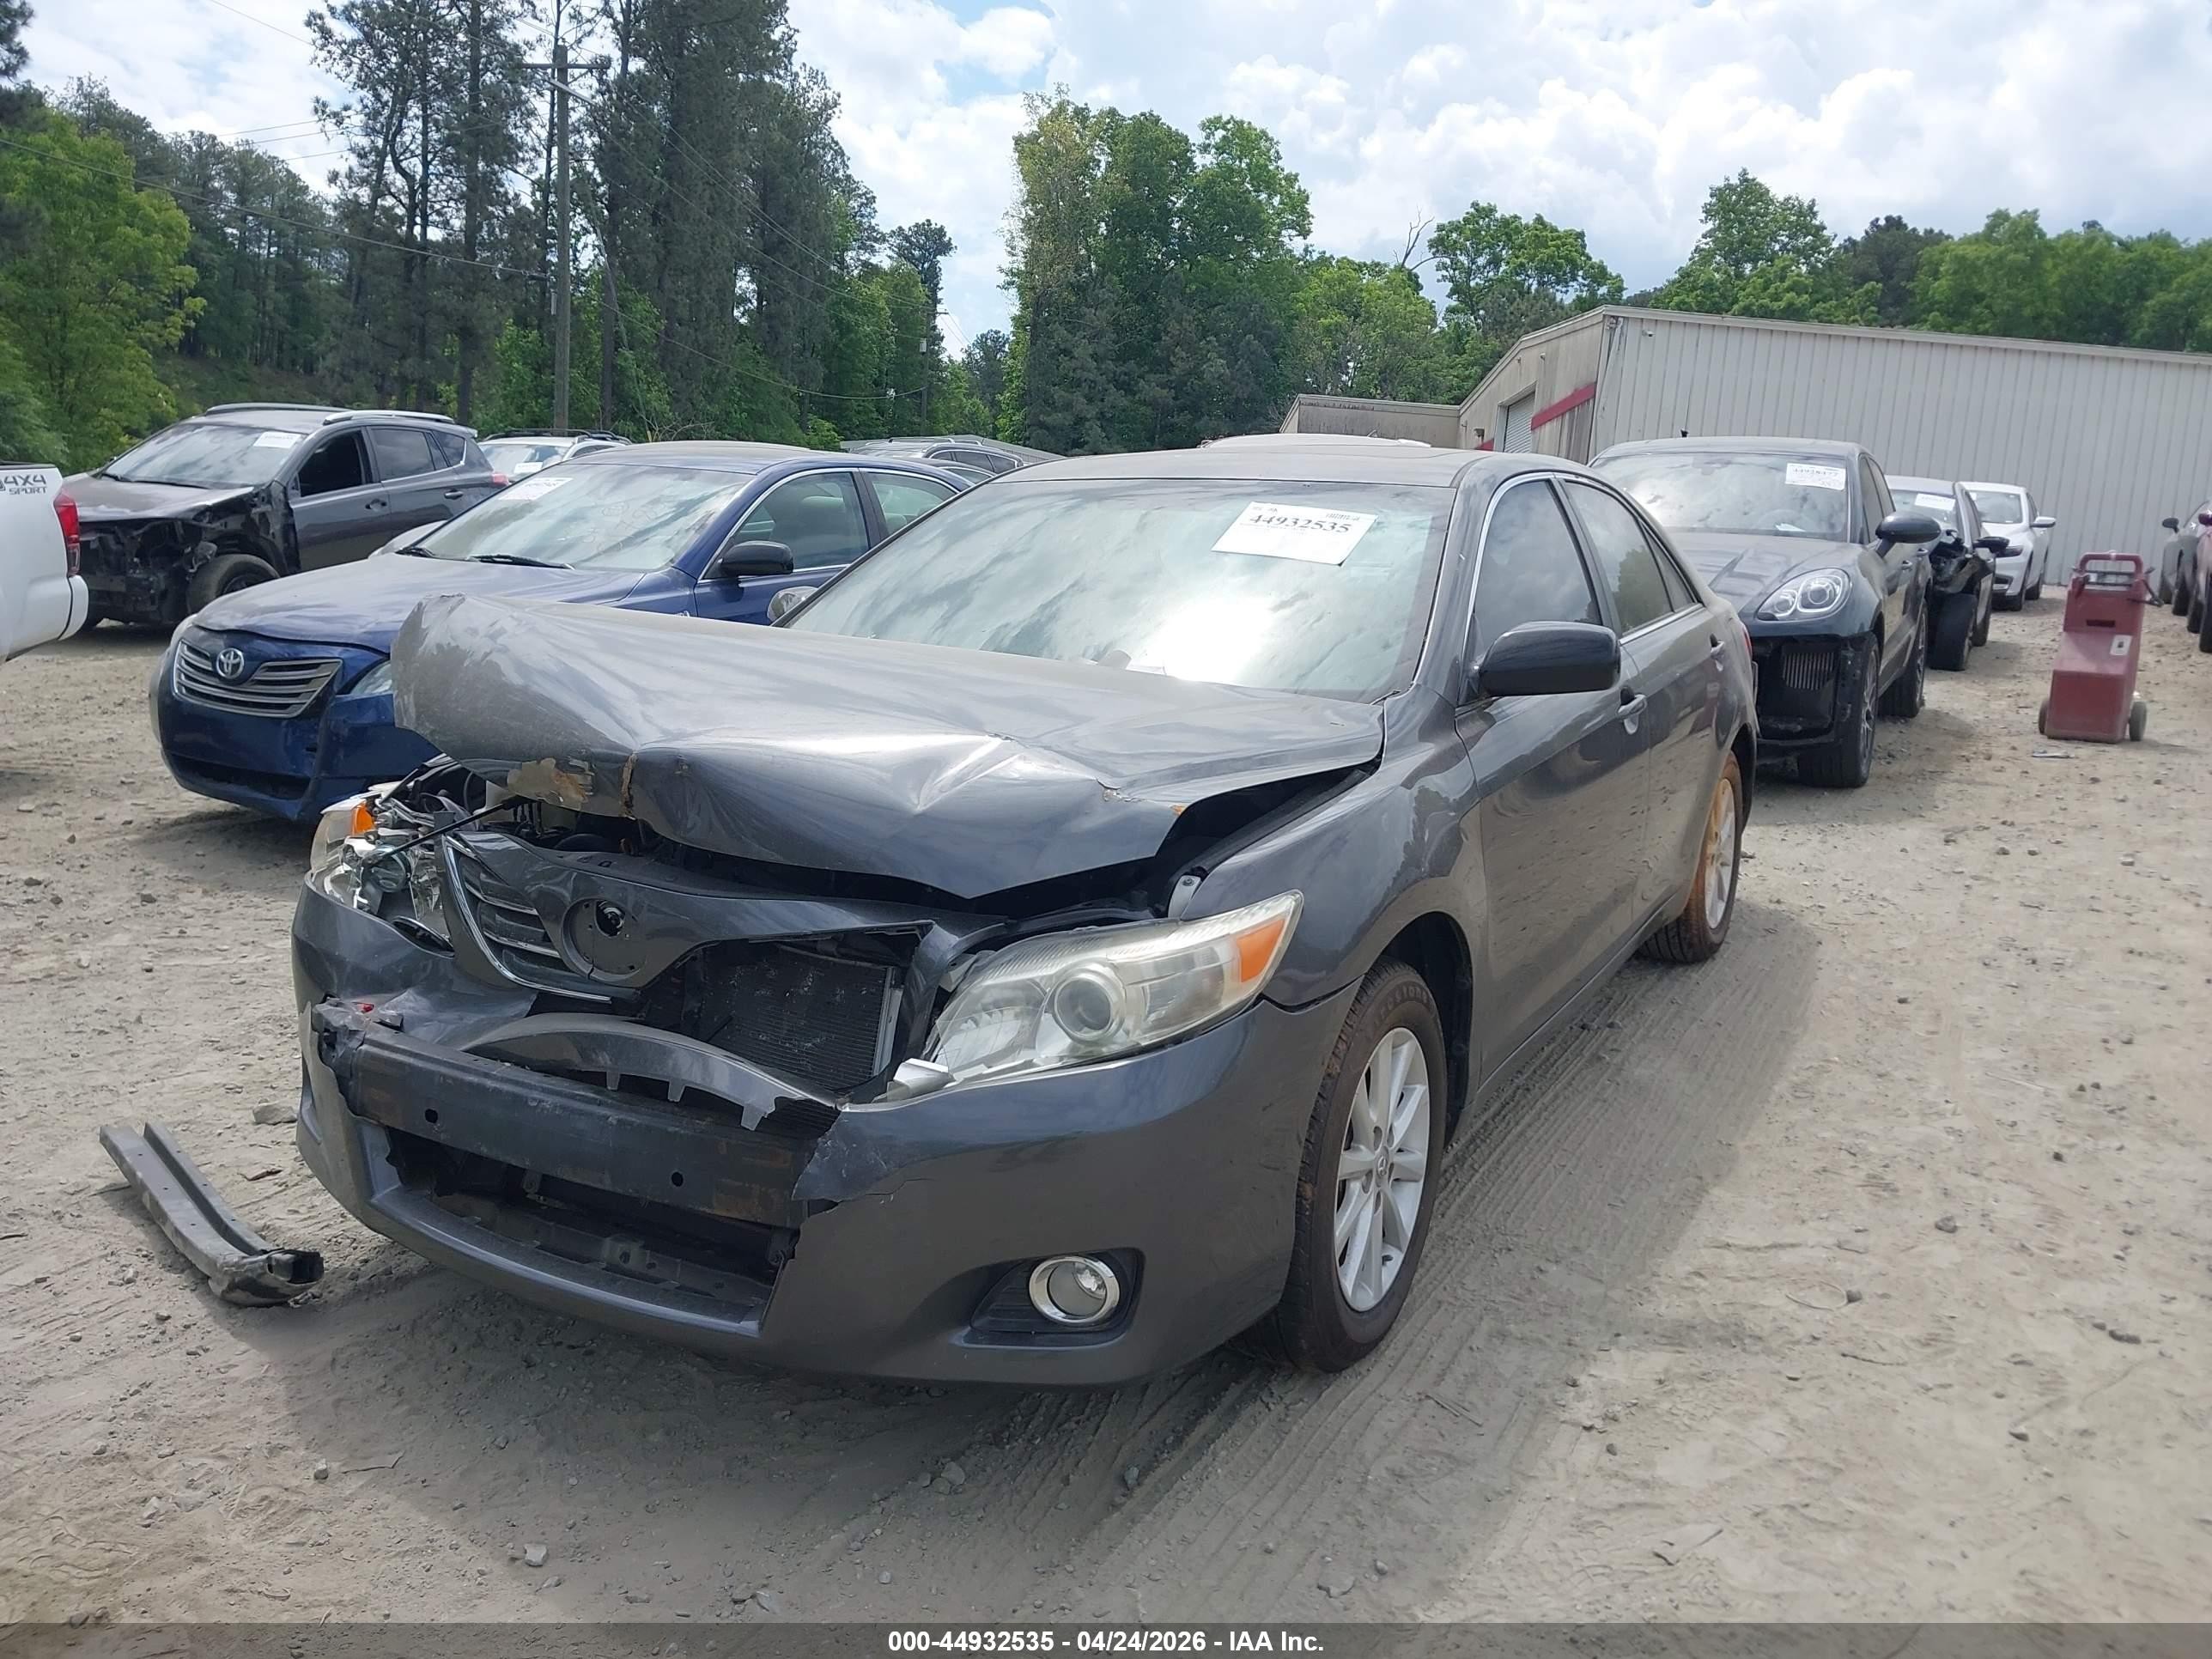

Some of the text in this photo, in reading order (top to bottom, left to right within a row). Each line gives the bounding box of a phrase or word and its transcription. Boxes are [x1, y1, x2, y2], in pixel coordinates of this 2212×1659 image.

[4, 474, 46, 486] 4X4
[9, 486, 47, 495] SPORT
[1249, 514, 1353, 534] 44932535
